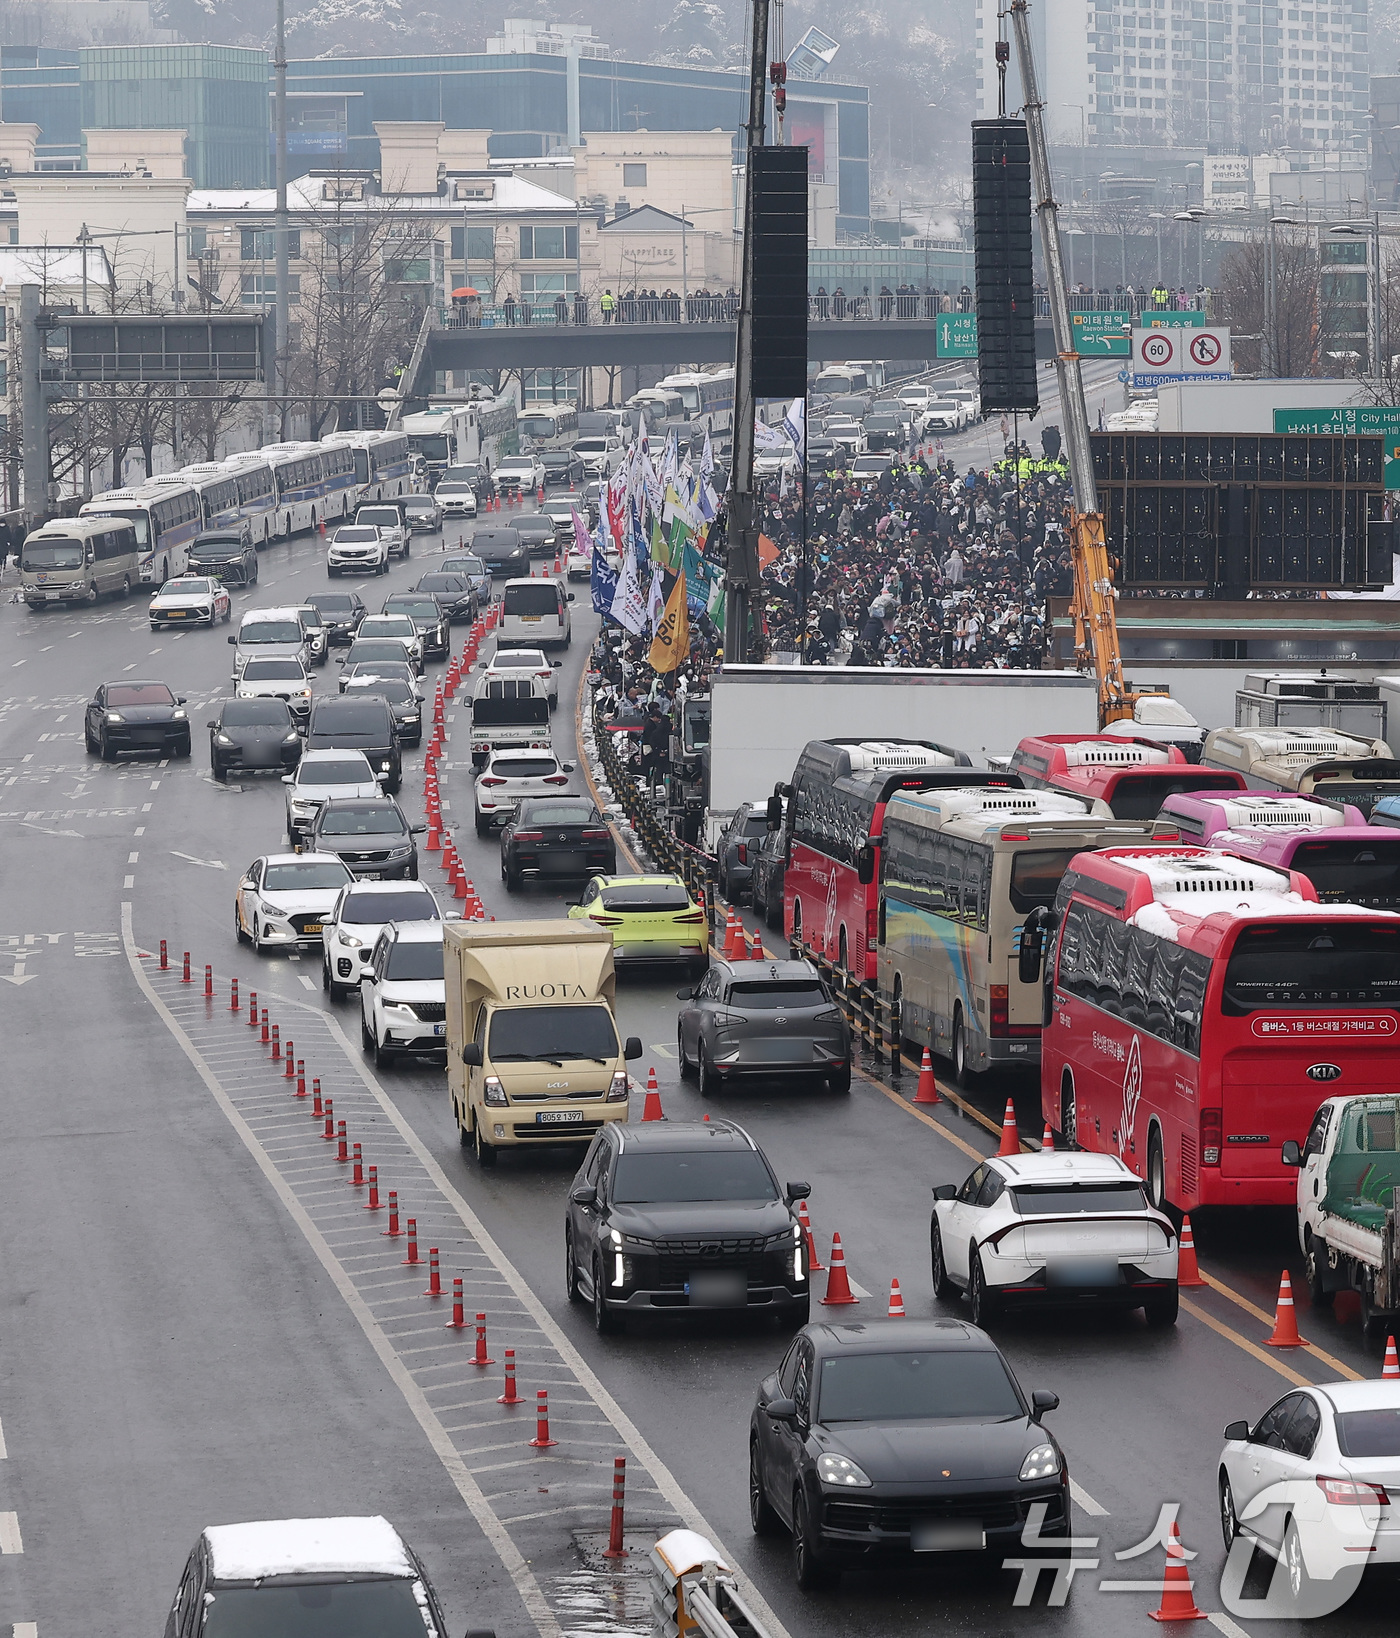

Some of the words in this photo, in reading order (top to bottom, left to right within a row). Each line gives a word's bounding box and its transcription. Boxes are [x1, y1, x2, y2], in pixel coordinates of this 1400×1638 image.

[954, 319, 971, 328] 시청
[1082, 315, 1123, 325] 이태원역
[1150, 344, 1164, 356] 60
[1136, 375, 1178, 386] 전방600m
[1331, 409, 1356, 422] 시청
[1361, 413, 1380, 424] City
[506, 983, 587, 1000] RUOTA
[1266, 990, 1382, 999] GRANBIRD
[1291, 1022, 1305, 1032] 1등
[1306, 1021, 1340, 1032] 버스대절
[1341, 1020, 1376, 1031] 가격비교
[1312, 1067, 1336, 1078] KIA
[547, 1081, 569, 1089] KIA
[563, 1112, 582, 1121] 1397
